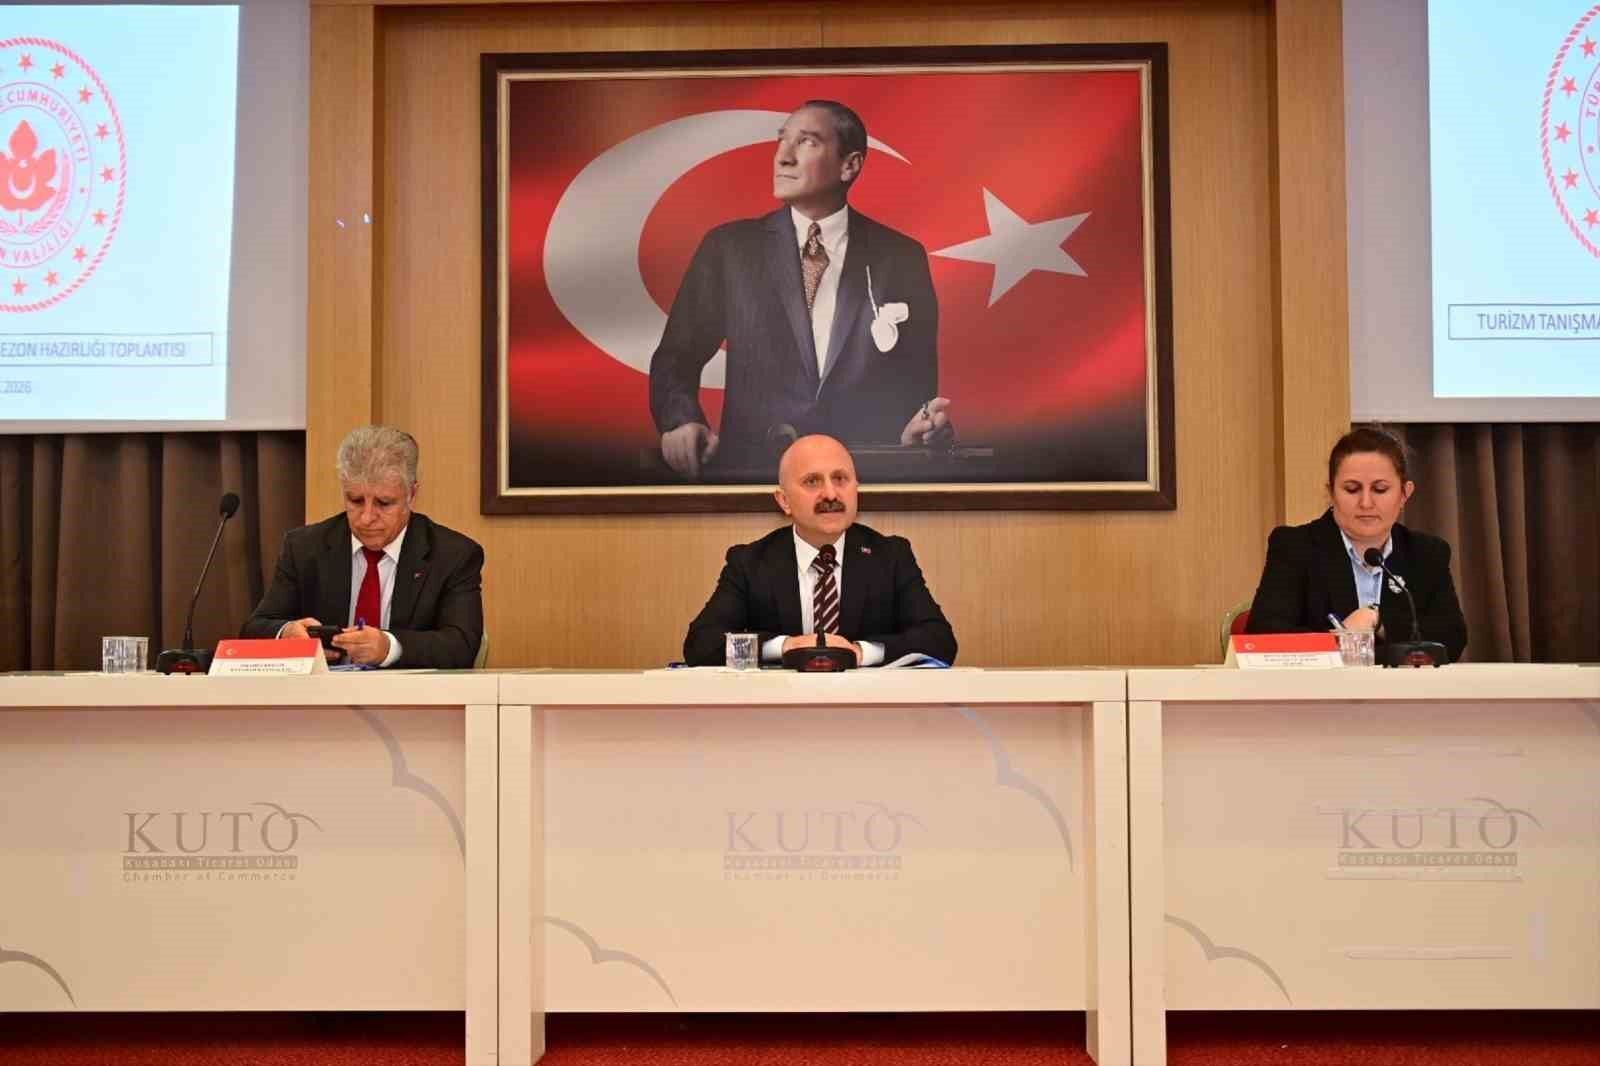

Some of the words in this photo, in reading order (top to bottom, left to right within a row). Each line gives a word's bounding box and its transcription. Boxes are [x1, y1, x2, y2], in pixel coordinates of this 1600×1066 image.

[1477, 309, 1536, 331] TURİZM
[110, 341, 186, 358] TOPLANTISI
[122, 811, 299, 853] KUTO
[725, 811, 903, 853] KUTO
[1338, 807, 1519, 849] KUTO
